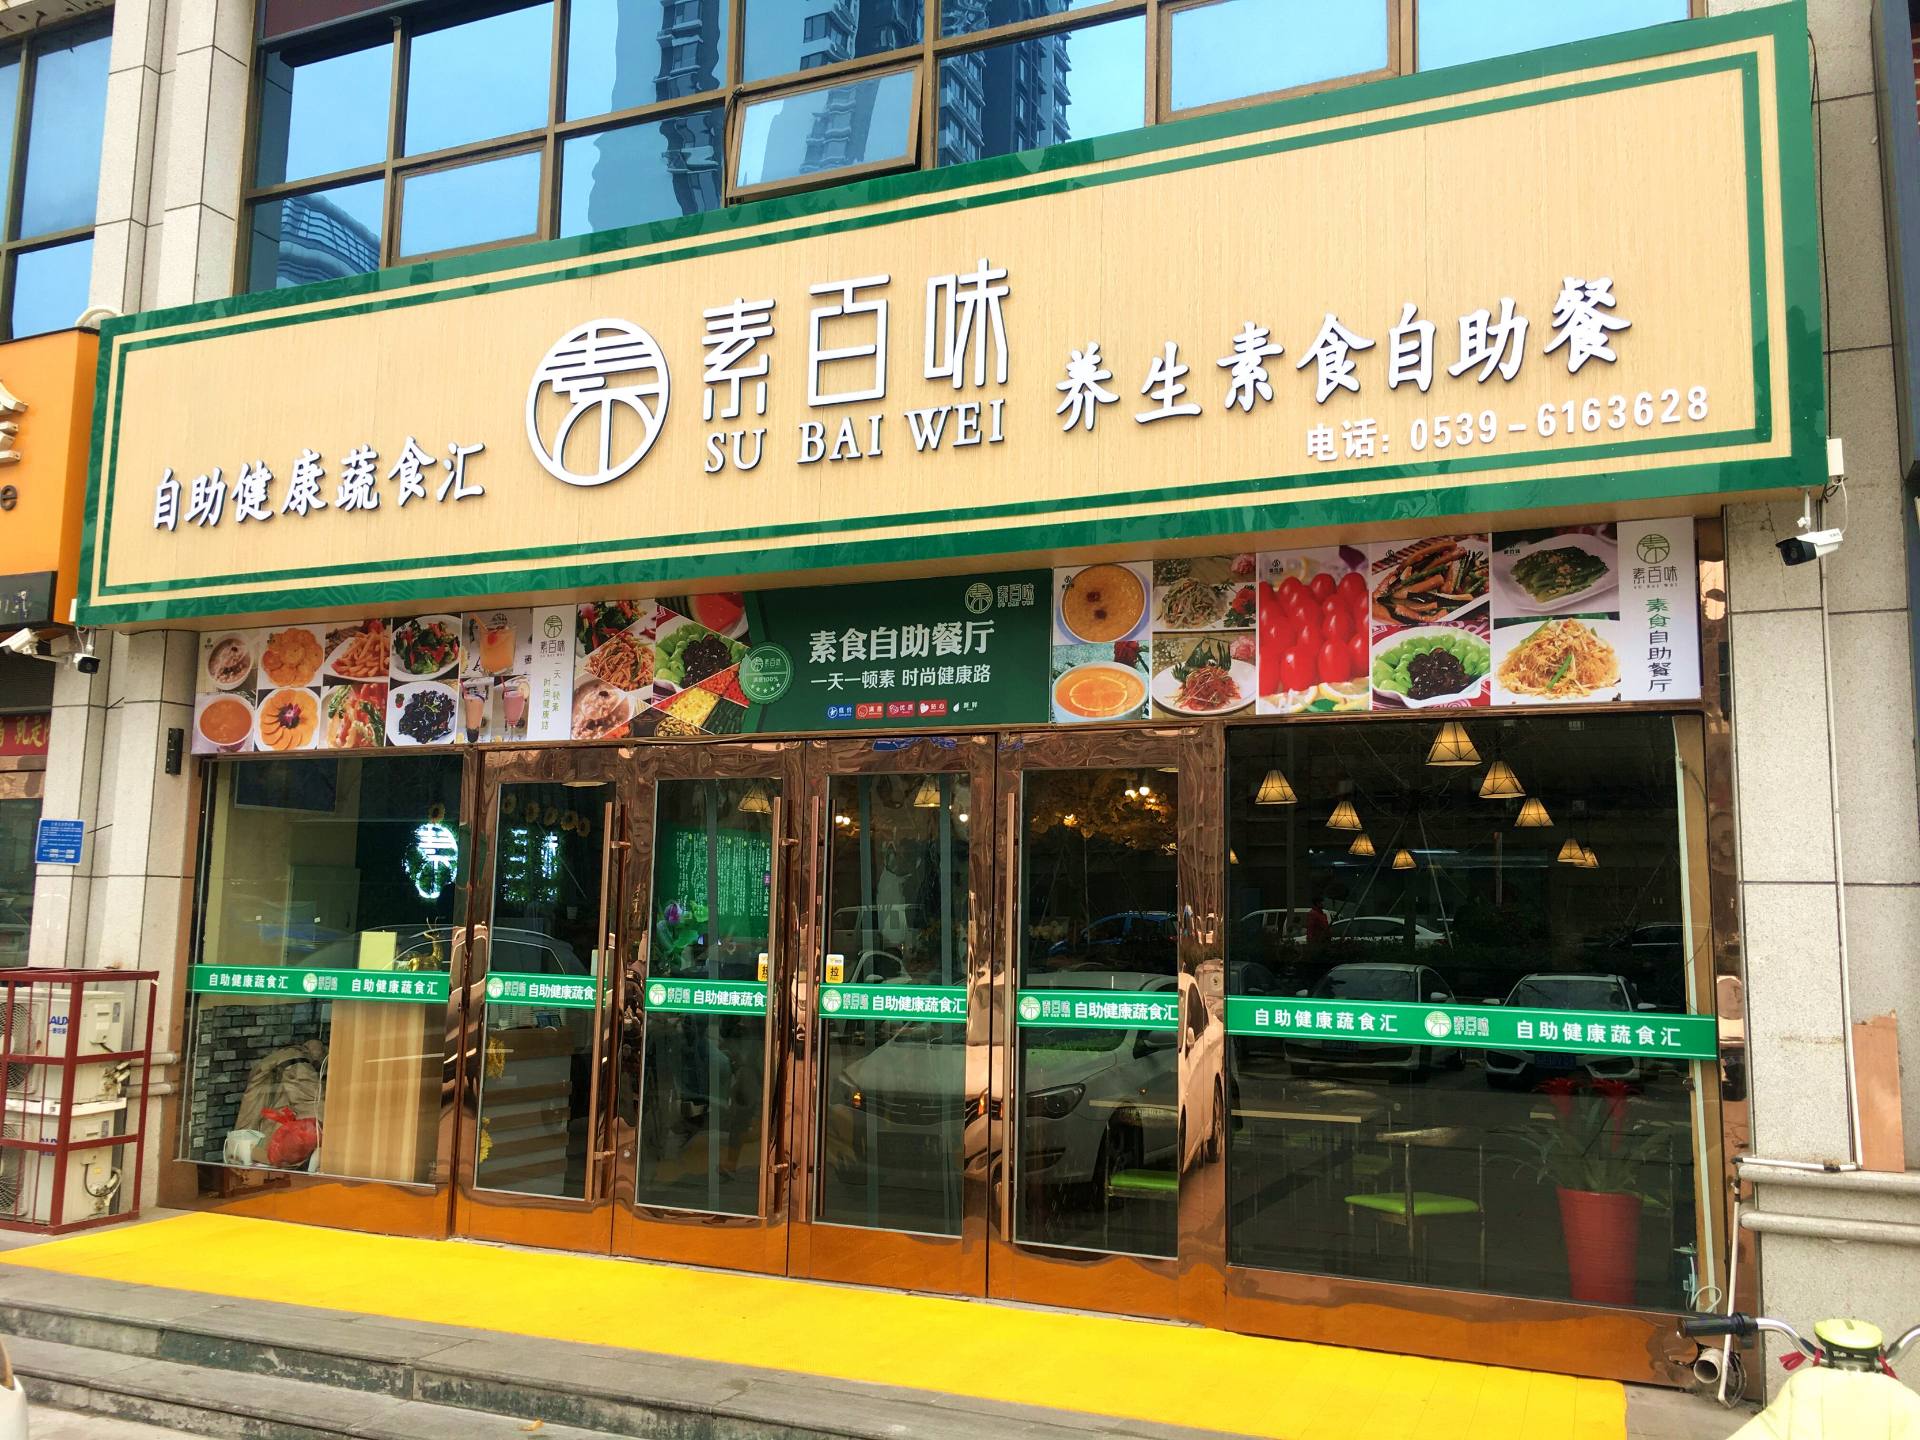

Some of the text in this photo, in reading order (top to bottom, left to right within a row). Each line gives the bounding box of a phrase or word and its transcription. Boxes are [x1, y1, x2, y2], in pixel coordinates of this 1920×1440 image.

[702, 258, 1011, 421] 素百味
[1055, 276, 1632, 433] 养生素食自助餐
[704, 399, 1007, 473] SU BAI WEI
[152, 435, 486, 533] 自助健康蔬食汇
[1633, 565, 1678, 584] 素百味
[809, 620, 995, 664] 素食自助餐厅
[1645, 597, 1672, 693] 素食自助餐厅
[811, 664, 991, 691] 一天一顿素 时尚健康路
[209, 973, 288, 989] 自助健康蔬食汇
[830, 966, 839, 977] 拉
[351, 978, 438, 995] 自助健康蔬食汇
[529, 983, 597, 1000] 自助健康蔬食
[694, 989, 767, 1007] 自助健康蔬食
[872, 995, 966, 1013] 自助健康蔬食汇
[1075, 1002, 1178, 1020] 自助健康蔬食汇
[1255, 1008, 1398, 1032] 自助健康蔬食汇
[1517, 1020, 1681, 1046] 自助健康蔬食汇
